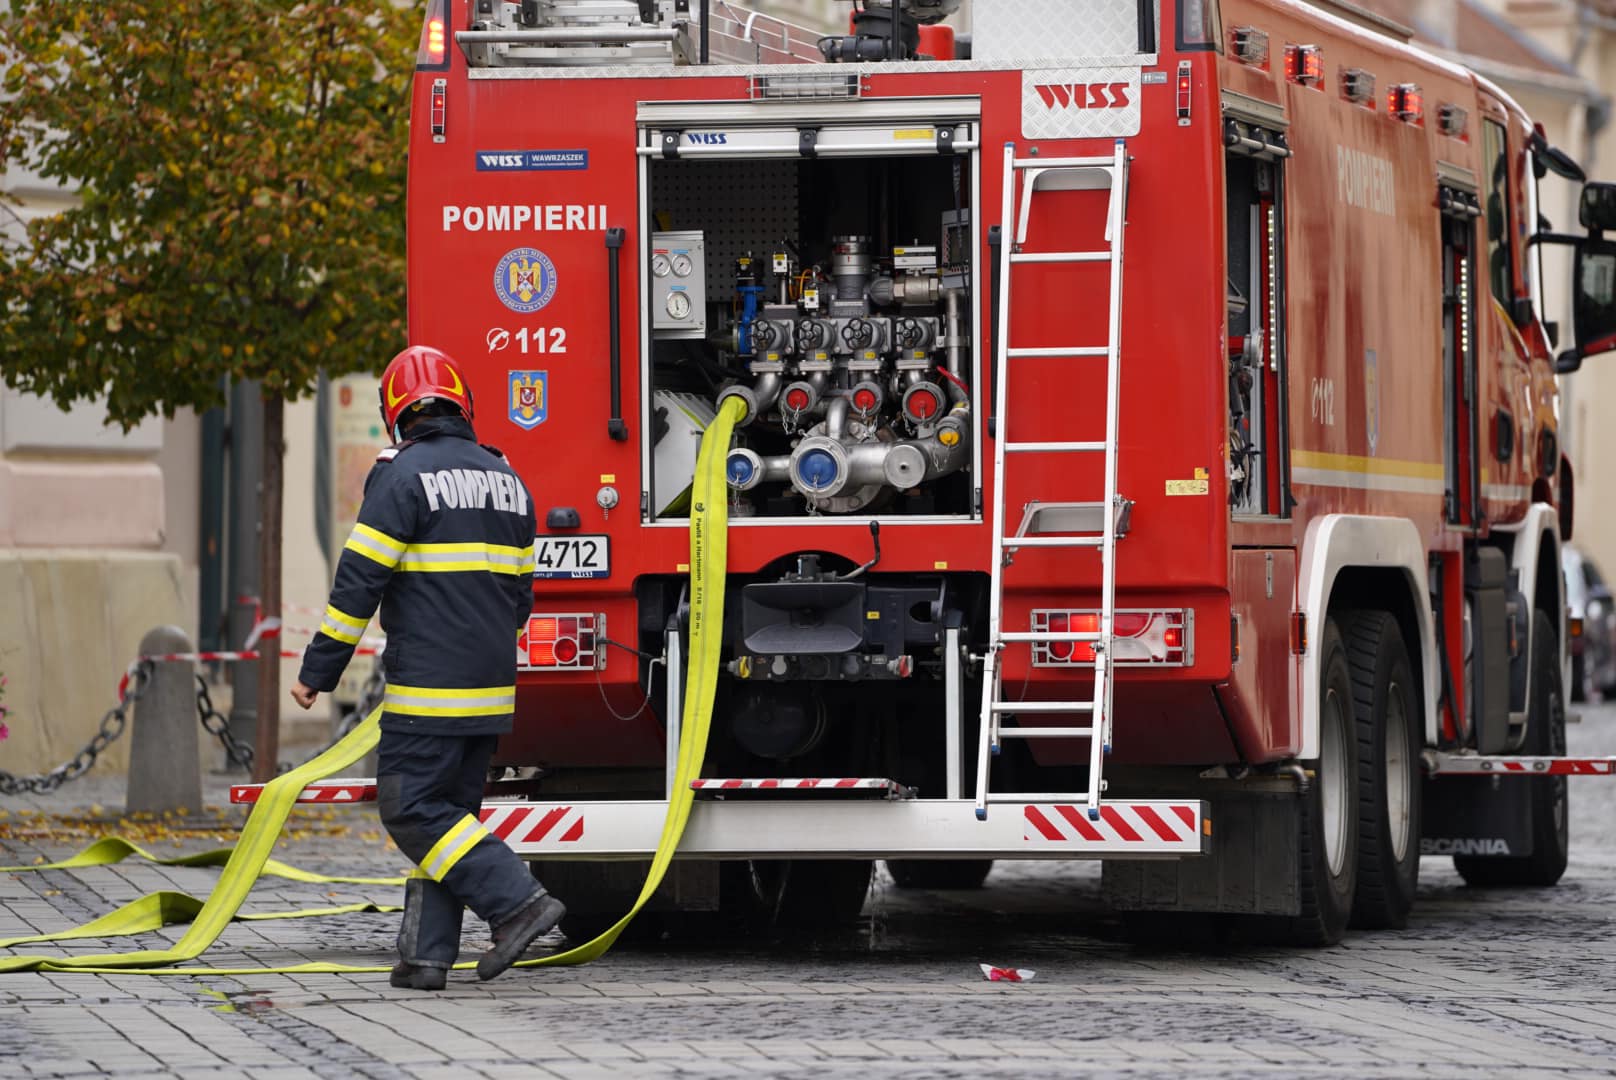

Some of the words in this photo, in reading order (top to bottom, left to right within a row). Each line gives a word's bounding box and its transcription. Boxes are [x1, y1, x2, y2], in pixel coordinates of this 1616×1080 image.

[1034, 82, 1130, 110] WISS
[687, 133, 727, 144] WISS
[480, 155, 523, 167] WISS
[531, 153, 584, 162] WAWRZASZEK
[442, 205, 607, 232] POMPIERII
[515, 327, 567, 353] 112
[537, 540, 598, 568] 4712
[1420, 838, 1510, 855] SCANIA
